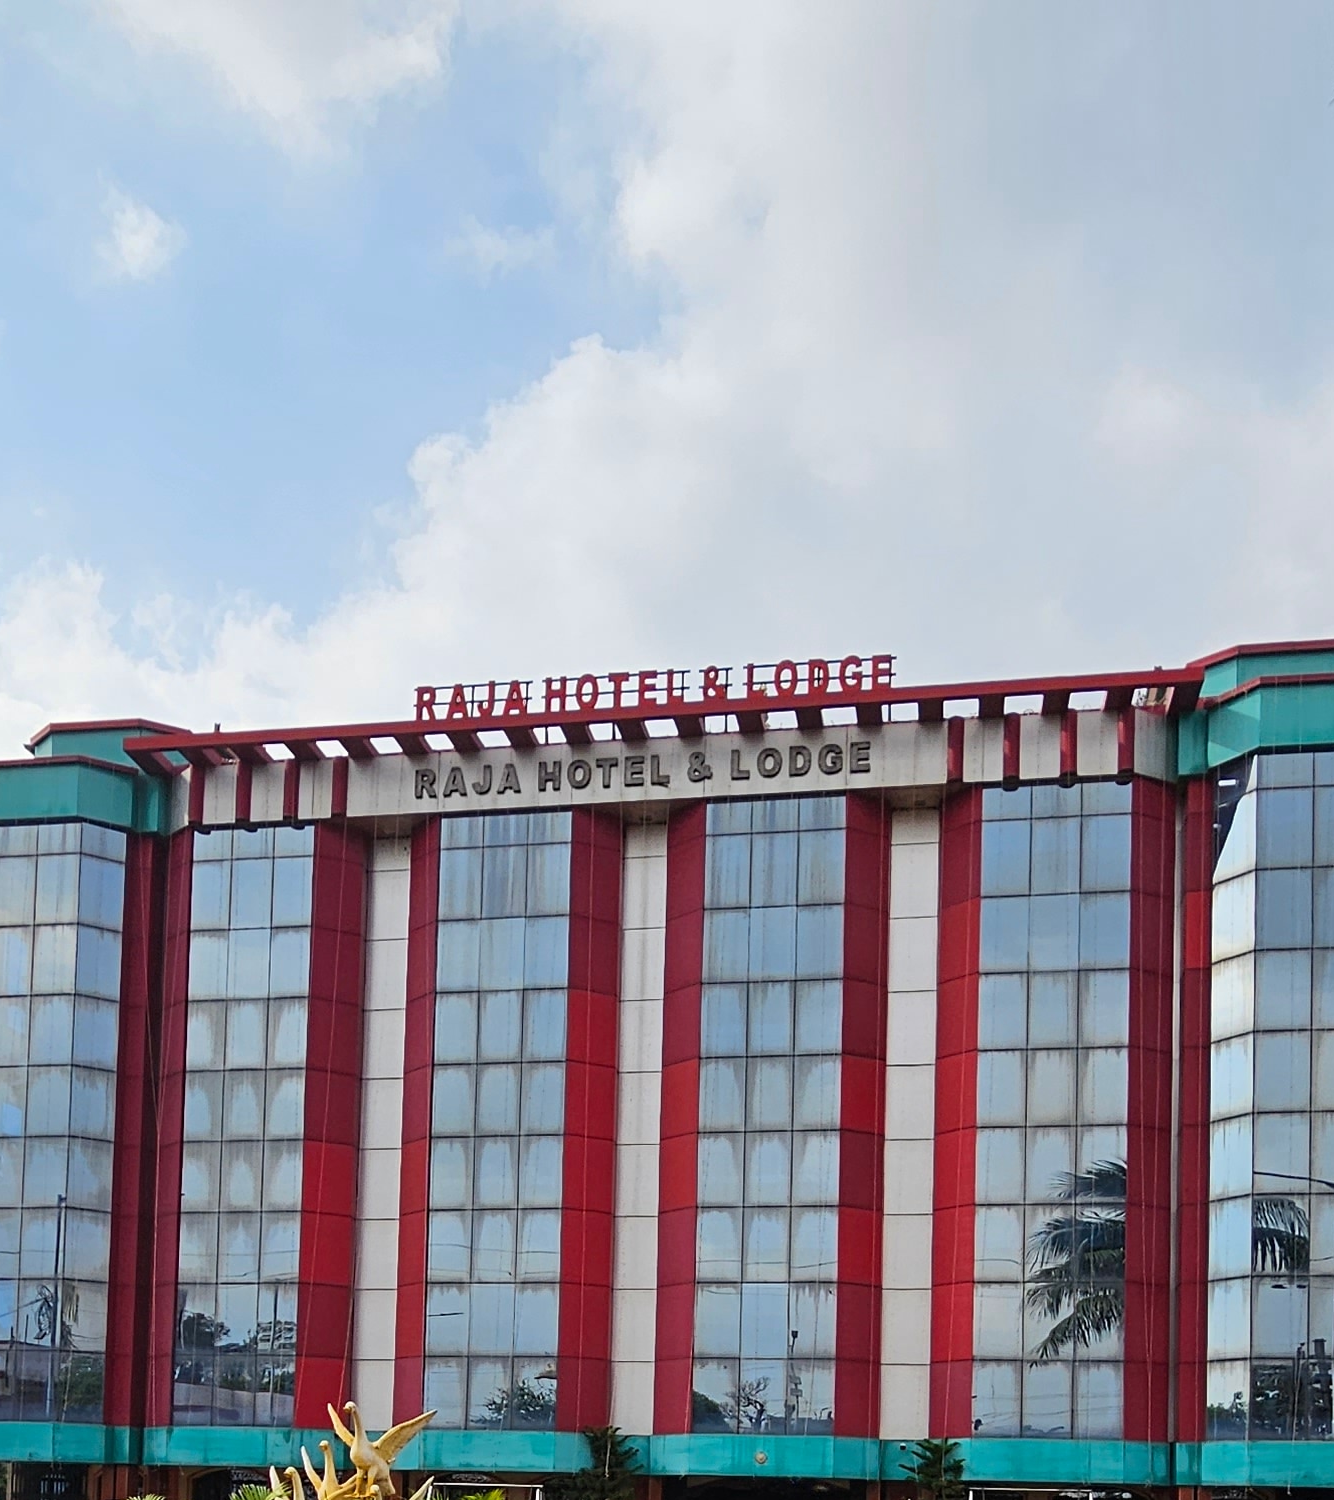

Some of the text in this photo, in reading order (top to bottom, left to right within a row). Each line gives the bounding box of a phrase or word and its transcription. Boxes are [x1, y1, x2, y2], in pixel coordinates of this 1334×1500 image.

[415, 655, 893, 721] RAJA HOTEL & LODGE
[414, 741, 872, 799] RAJA HOTEL & LODGE
